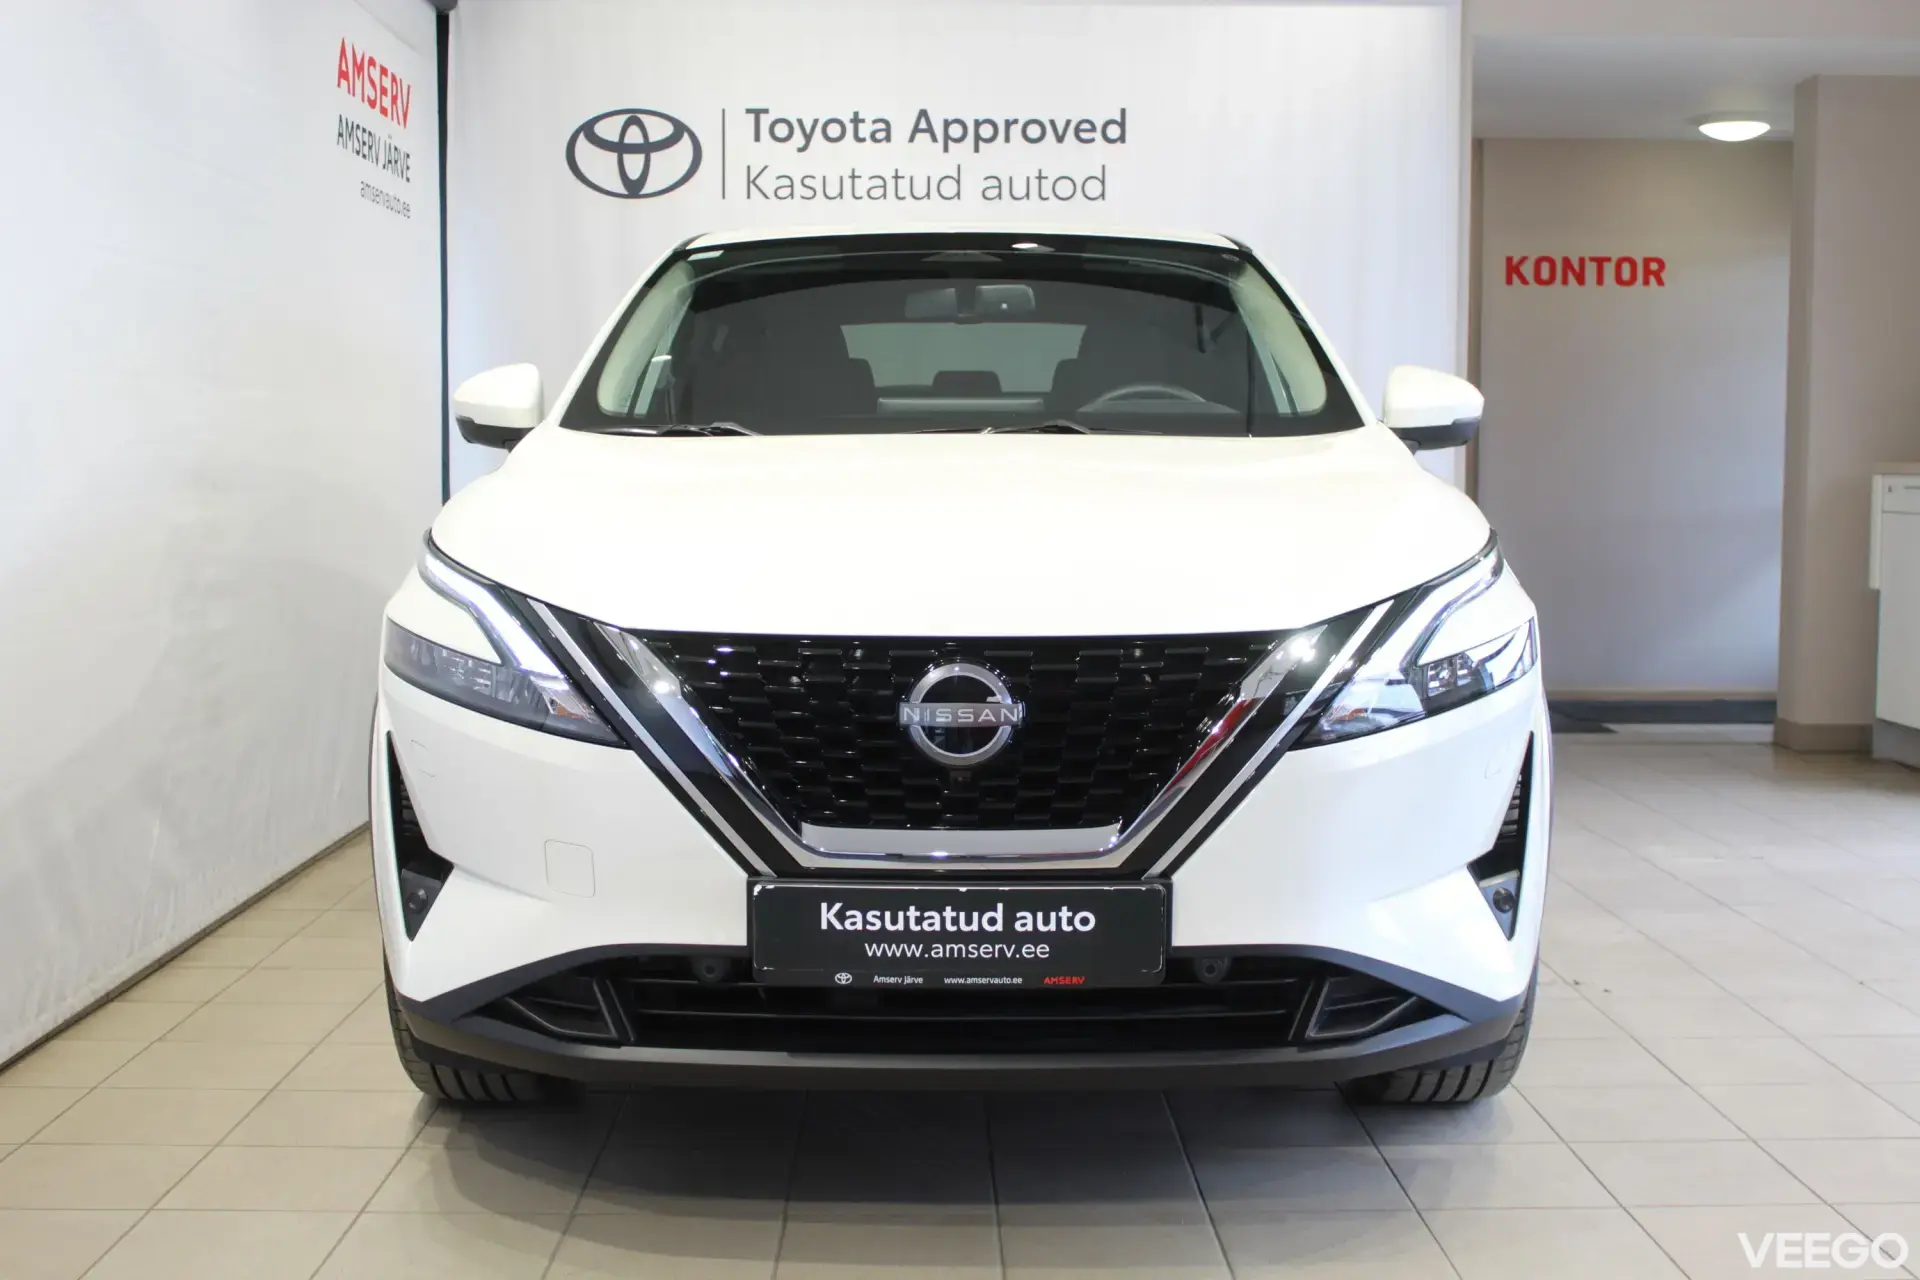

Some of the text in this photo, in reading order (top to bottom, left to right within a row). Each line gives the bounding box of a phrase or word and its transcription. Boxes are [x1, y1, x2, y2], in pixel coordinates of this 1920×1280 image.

[337, 37, 411, 129] AMSERV
[746, 108, 1128, 153] Toyota Approved
[337, 114, 411, 183] AMSERV JÄRVE
[746, 164, 1107, 201] Kasutatud autod
[360, 181, 411, 219] amservauto.ee
[1505, 255, 1666, 287] KONTOR
[903, 707, 1018, 723] NISSAN
[820, 902, 1096, 932] Kasutatud auto
[864, 941, 1051, 958] www.amserv.ee
[873, 975, 1086, 985] Amserv Järve www.amservauto.ee AMSERV
